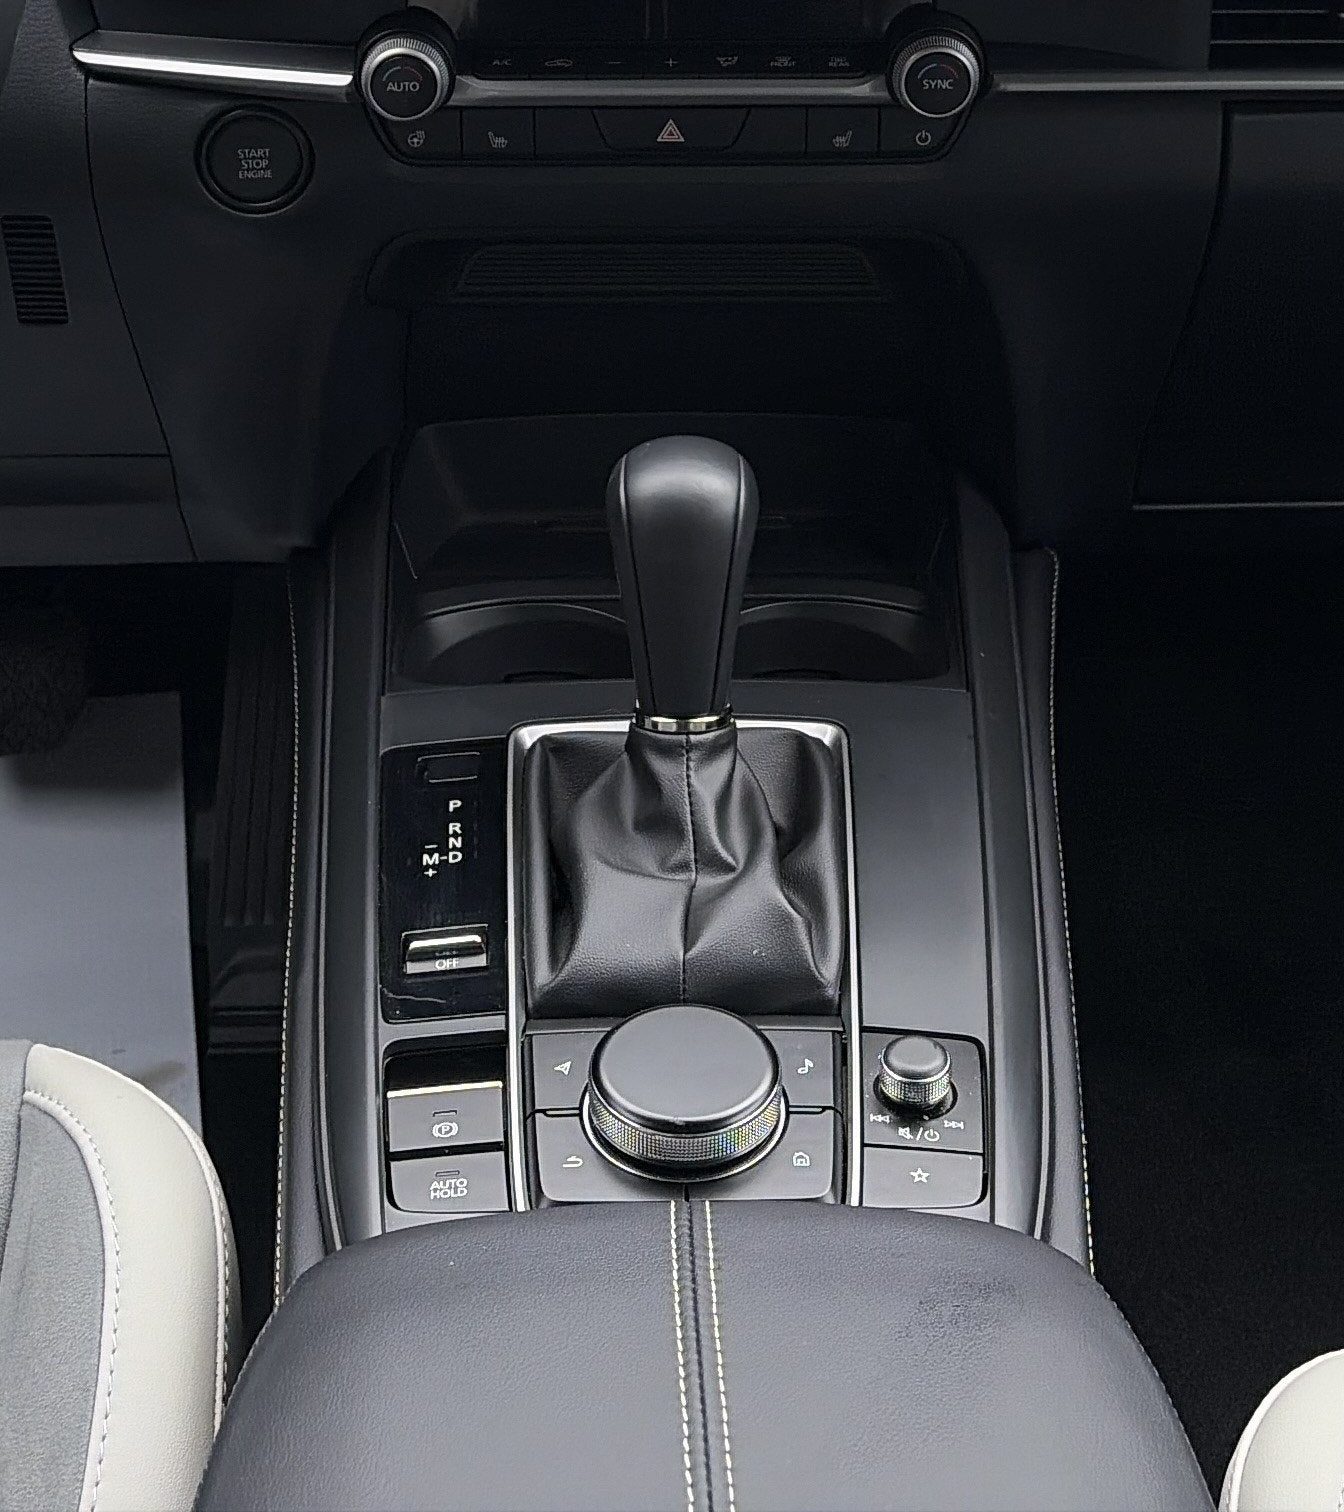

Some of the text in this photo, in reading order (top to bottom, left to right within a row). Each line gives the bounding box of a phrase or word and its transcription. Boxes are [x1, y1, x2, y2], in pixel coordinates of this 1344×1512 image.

[386, 81, 420, 92] AUTO
[922, 78, 954, 90] SYNC
[237, 148, 270, 159] START
[241, 158, 269, 169] STOP
[238, 169, 272, 179] ENGINE
[448, 799, 462, 812] P
[448, 822, 462, 835] R
[448, 836, 462, 849] N
[435, 958, 459, 970] OFF
[430, 1178, 467, 1190] AUTO
[430, 1188, 467, 1200] HOLD
